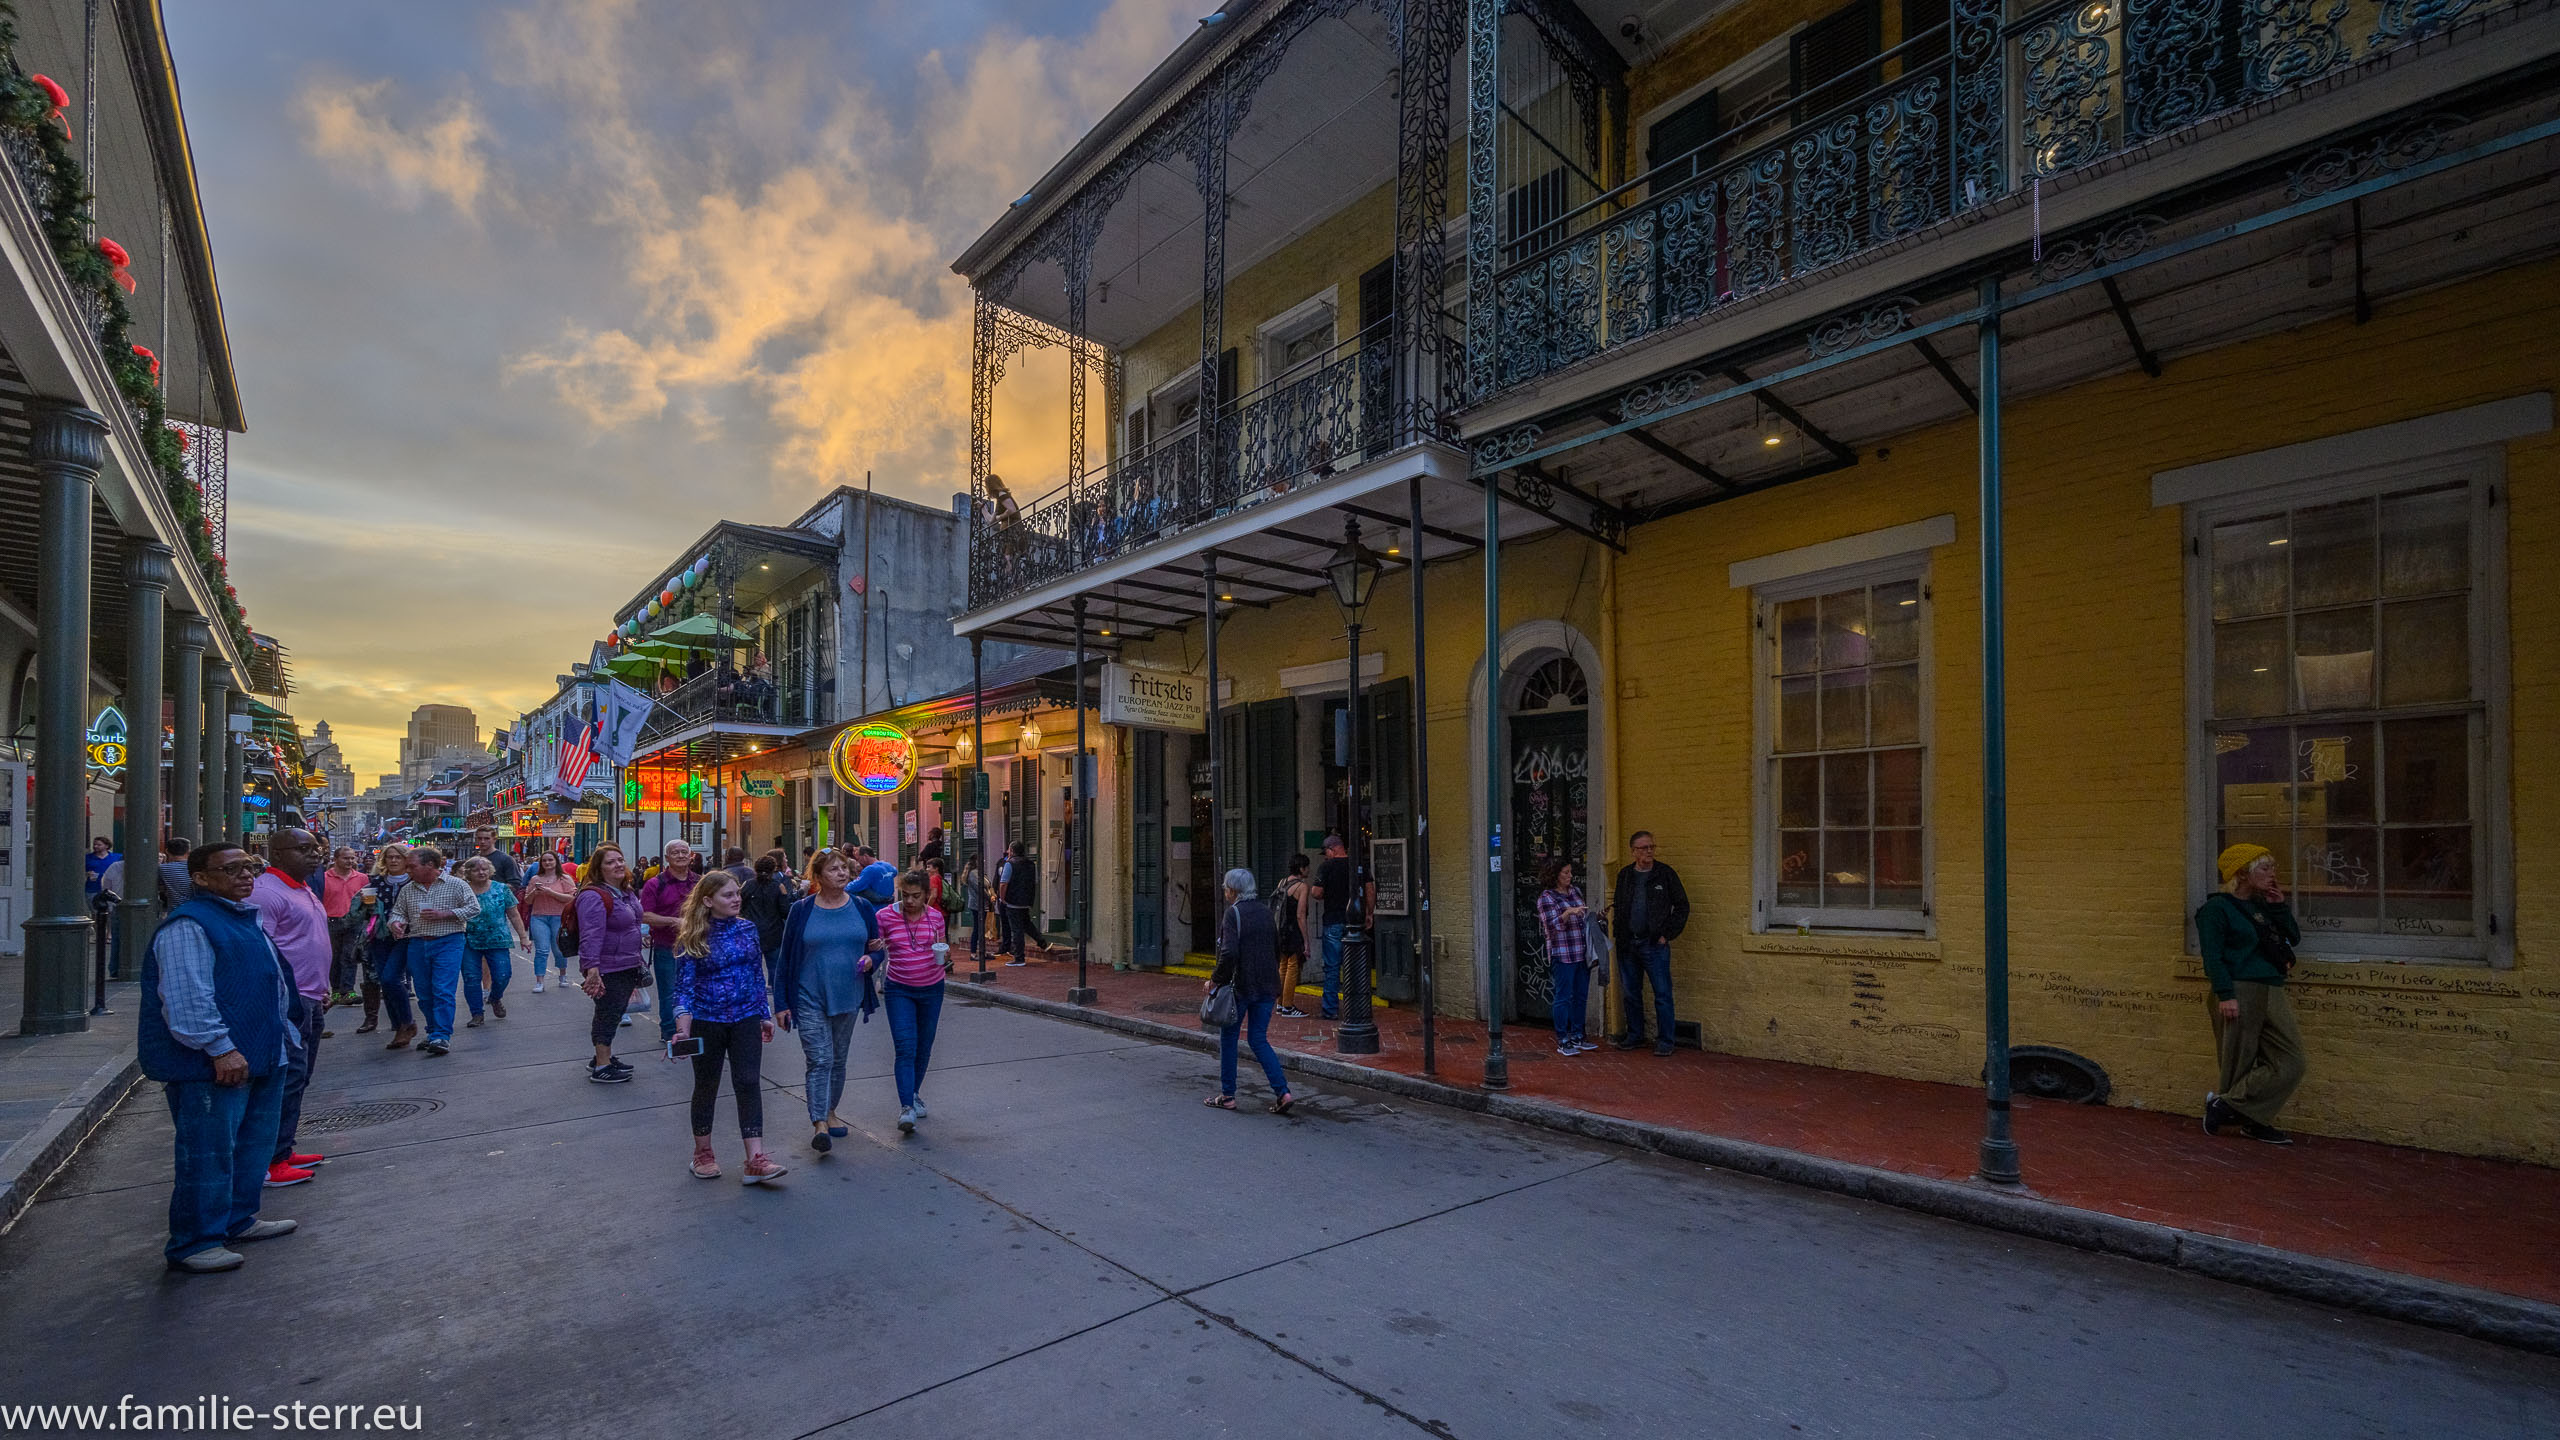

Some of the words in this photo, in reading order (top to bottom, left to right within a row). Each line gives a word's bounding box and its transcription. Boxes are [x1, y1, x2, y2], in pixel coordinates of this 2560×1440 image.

[1130, 672, 1192, 702] fritzel's
[1118, 695, 1162, 709] EUROPEAN
[1164, 701, 1184, 711] JAZZ
[1186, 704, 1201, 713] PUB
[1137, 706, 1156, 715] Orleans
